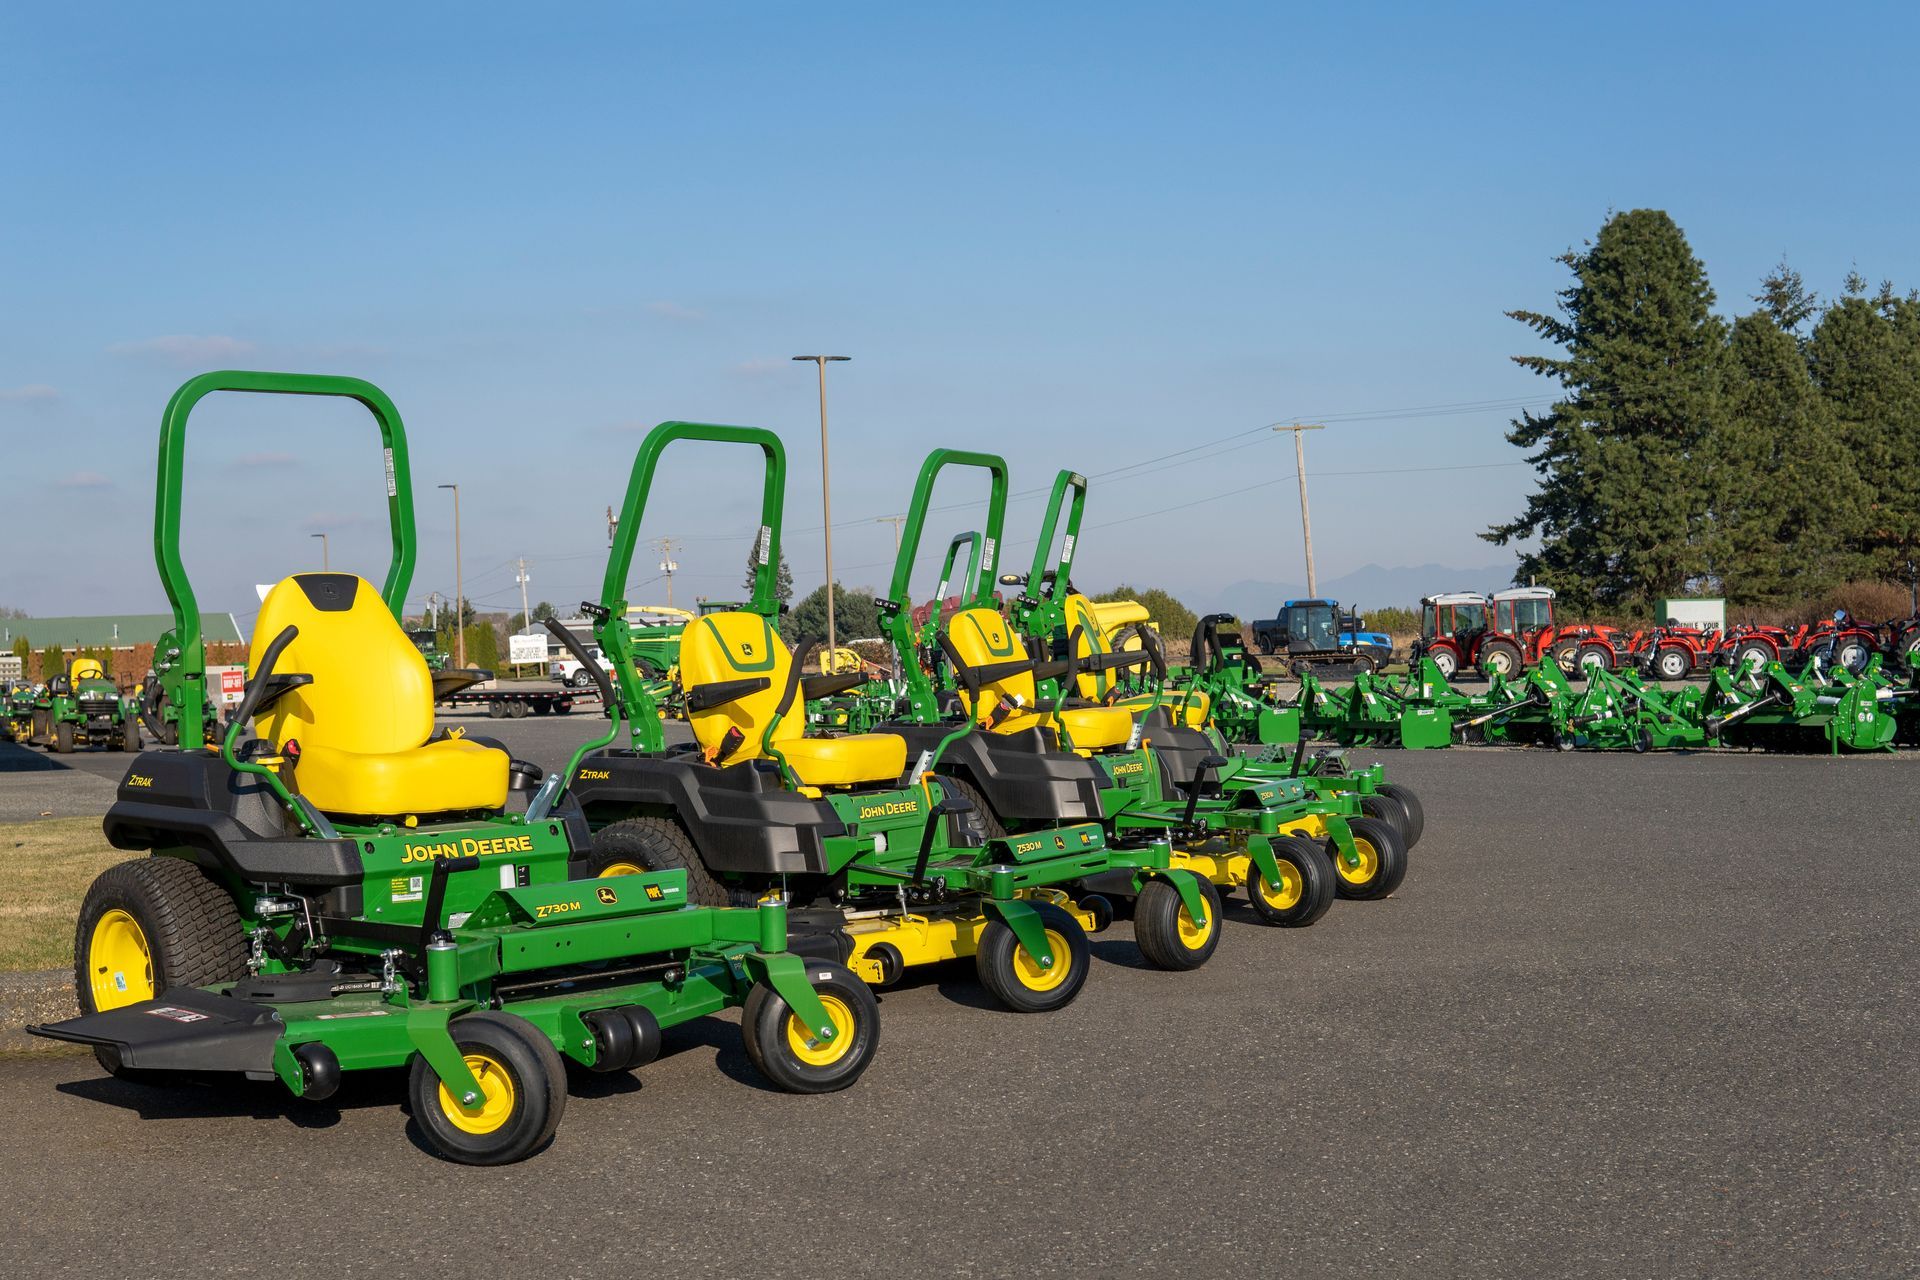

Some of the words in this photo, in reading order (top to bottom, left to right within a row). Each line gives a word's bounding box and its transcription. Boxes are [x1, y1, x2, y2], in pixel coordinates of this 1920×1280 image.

[128, 774, 154, 787] ZTRAK
[579, 769, 610, 779] ZTRAK
[859, 806, 885, 819] JOHN
[885, 801, 918, 815] DEERE
[401, 843, 460, 864] JOHN
[460, 835, 535, 858] DEERE
[1016, 842, 1035, 855] Z530
[1035, 841, 1042, 850] M
[535, 903, 569, 918] Z730
[569, 901, 581, 911] M
